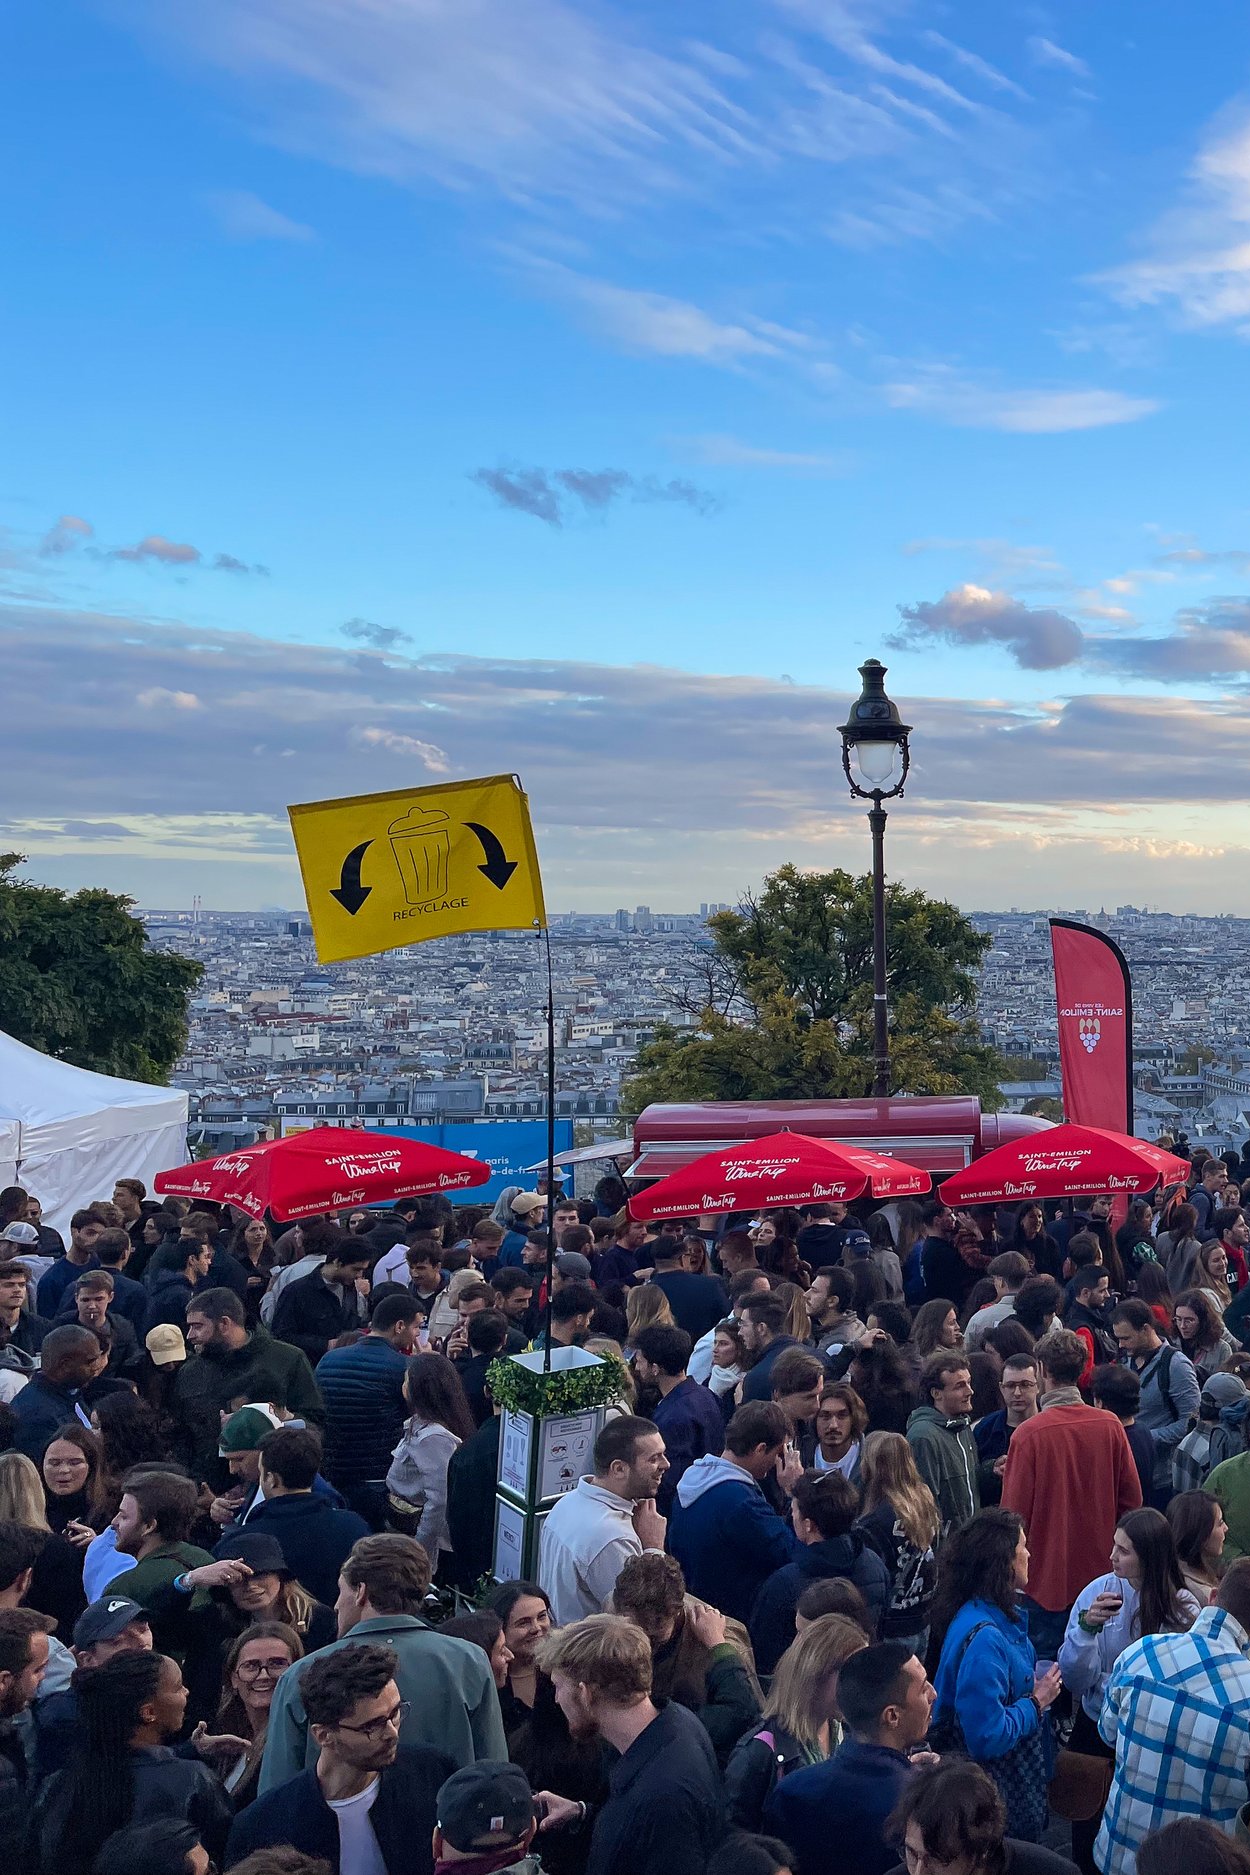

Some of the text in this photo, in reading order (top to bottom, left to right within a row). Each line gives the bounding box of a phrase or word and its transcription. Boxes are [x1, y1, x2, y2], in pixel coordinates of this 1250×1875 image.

[393, 897, 470, 921] RECYCLAGE
[324, 1149, 402, 1166] SAINT-EMILION
[1018, 1149, 1092, 1160] SAINT-EMILION
[720, 1157, 800, 1167] SAINT-EMILION
[393, 1182, 437, 1195] SAINT-EMILION
[1064, 1183, 1107, 1191] SAINT-EMILION
[766, 1192, 811, 1201] SAINT-EMILION
[960, 1189, 1003, 1200] SAINT-EMILION
[288, 1200, 330, 1216] SAINT-EMILION
[652, 1203, 700, 1214] SAINT-EMILION
